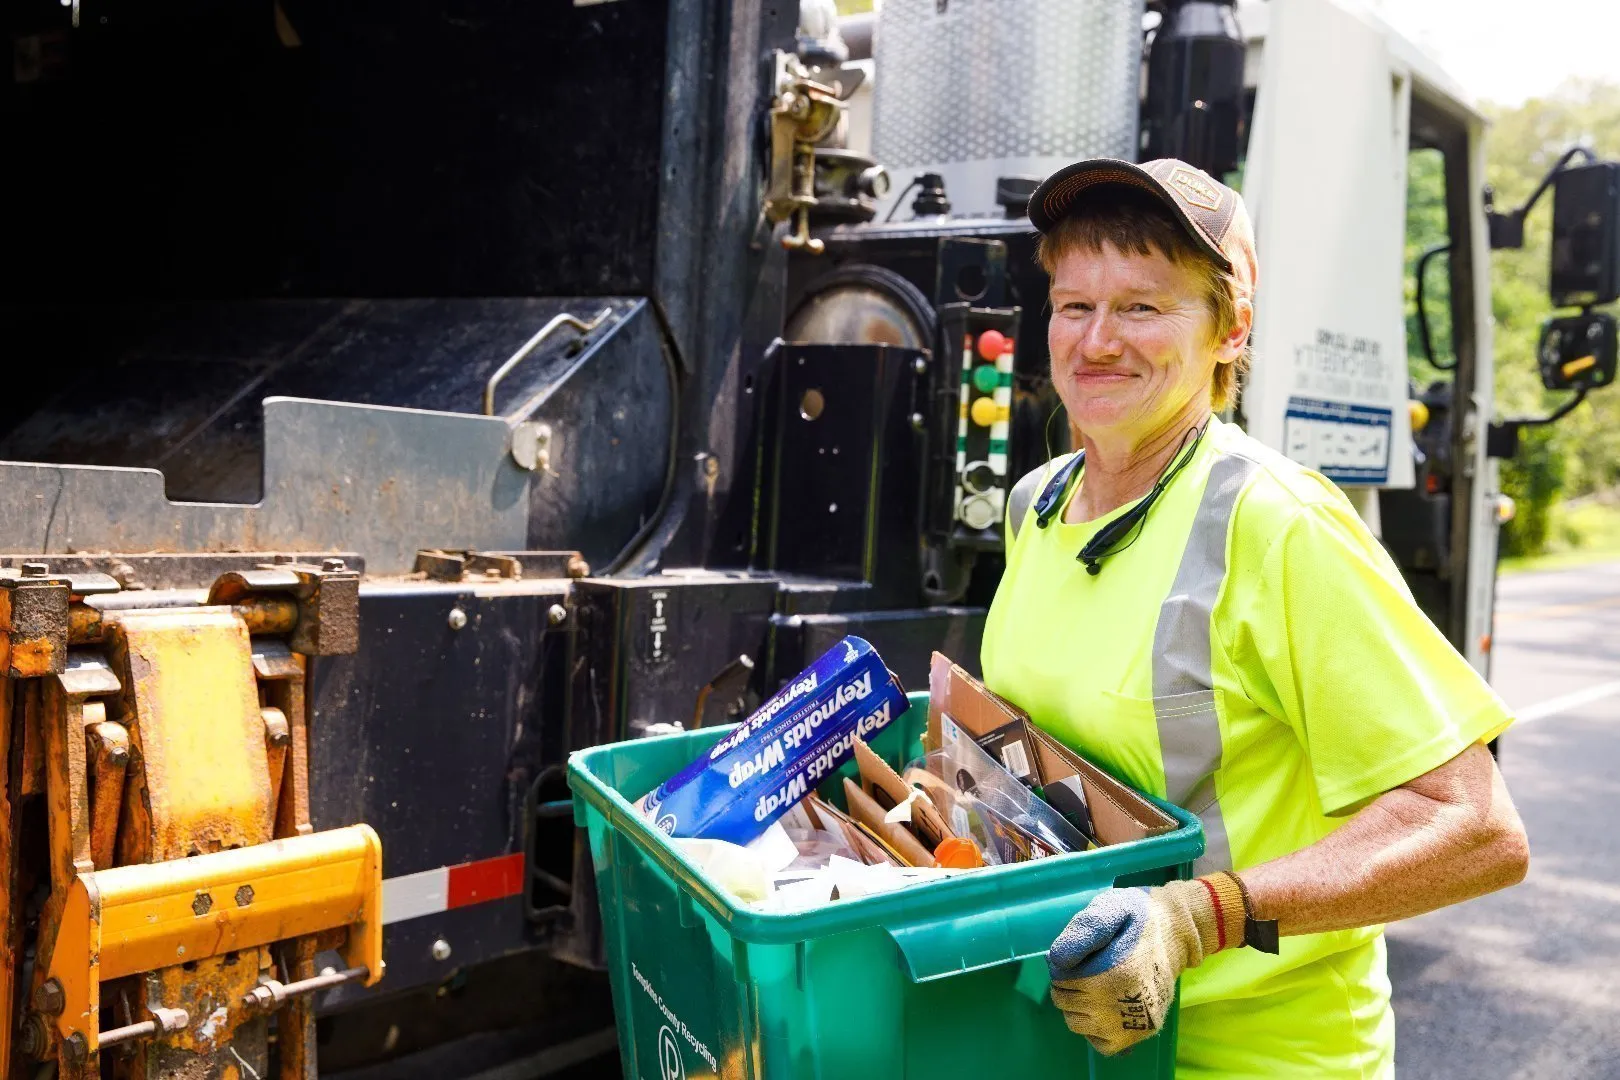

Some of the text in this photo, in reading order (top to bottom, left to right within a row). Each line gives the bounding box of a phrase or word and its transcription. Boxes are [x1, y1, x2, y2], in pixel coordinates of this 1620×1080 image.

[749, 672, 818, 730] Reynolds
[783, 670, 873, 750] Reynolds
[792, 699, 819, 721] TRUSTED
[710, 726, 751, 760] Wrap
[773, 718, 793, 734] SINCE
[807, 701, 891, 780] Reynolds
[728, 741, 786, 789] Wrap
[754, 778, 808, 822] Wrap
[632, 962, 717, 1073] Tompkins County Recycling
